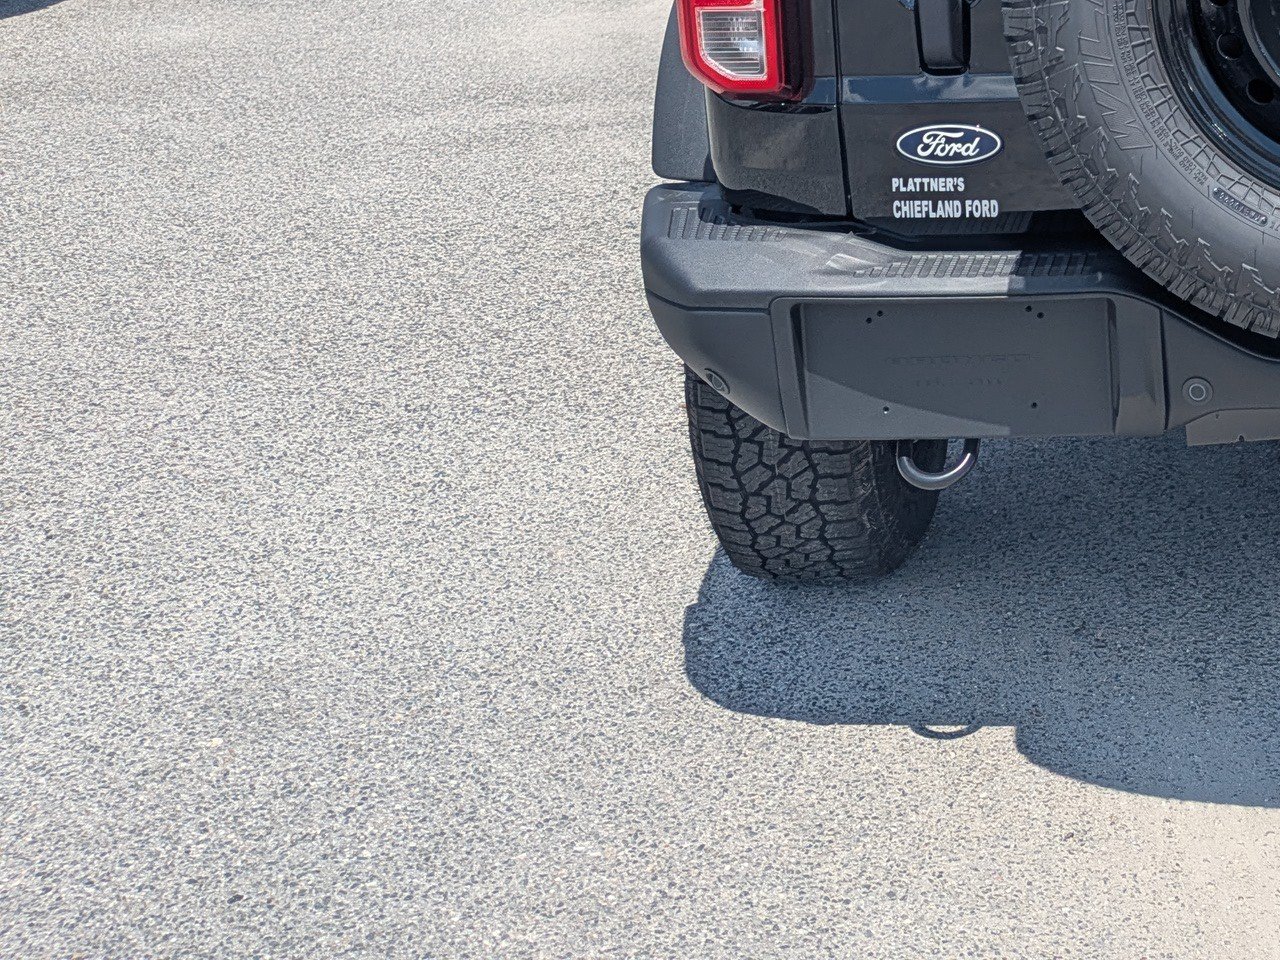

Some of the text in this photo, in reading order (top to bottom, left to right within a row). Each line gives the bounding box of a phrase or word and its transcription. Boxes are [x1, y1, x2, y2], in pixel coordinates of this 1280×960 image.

[916, 130, 981, 158] Ford
[891, 177, 965, 192] PLATTNER'S
[892, 199, 999, 219] CHIEFLAND FORD
